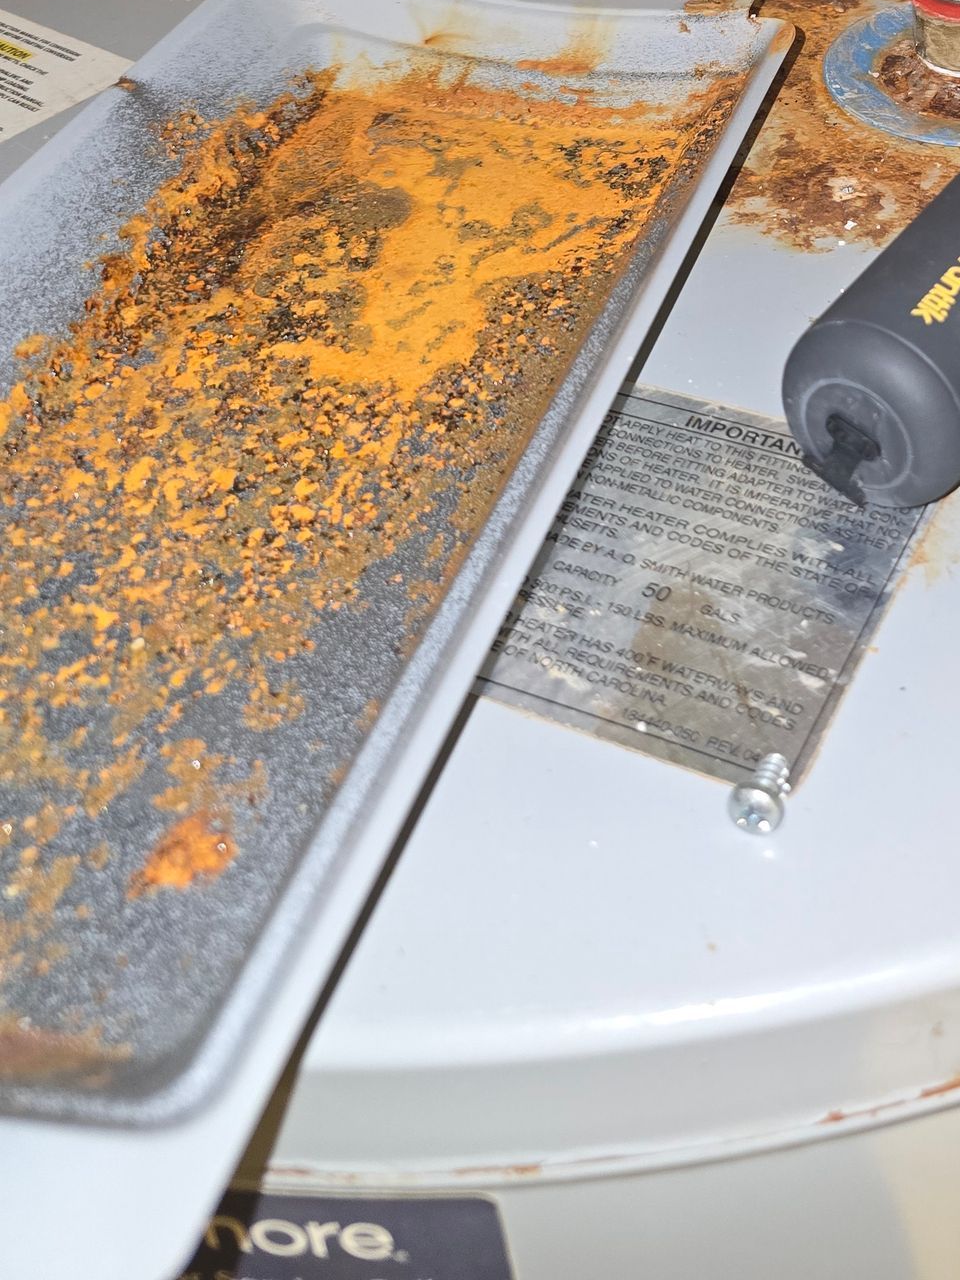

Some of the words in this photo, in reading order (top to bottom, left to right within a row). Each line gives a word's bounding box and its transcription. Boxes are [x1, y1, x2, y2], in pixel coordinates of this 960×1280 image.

[0, 40, 33, 60] AUTION
[612, 426, 703, 460] CONNECTIONS
[704, 452, 722, 463] TO
[724, 457, 781, 480] HEATER.
[620, 417, 662, 435] APPLY
[667, 429, 701, 446] HEAT
[701, 438, 722, 451] TO
[724, 444, 756, 460] THIS
[757, 453, 812, 475] FITTING
[685, 414, 803, 458] IMPORTAN
[584, 470, 682, 506] NON-METALLIC
[682, 498, 781, 534] COMPONENTS.
[592, 461, 651, 485] APPLIED
[653, 477, 671, 489] TO
[673, 482, 721, 503] WATER
[723, 495, 830, 534] CONNECTIONS
[833, 527, 852, 538] AS
[854, 533, 895, 551] THEY
[615, 440, 670, 464] BEFORE
[674, 456, 726, 478] FITTING
[727, 470, 794, 496] ADAPTER
[796, 489, 814, 501] TO
[817, 495, 865, 516] WATER
[620, 455, 640, 467] OF
[642, 460, 701, 484] HEATER.
[708, 478, 723, 488] IT
[725, 482, 741, 493] IS
[743, 486, 831, 520] IMPERATIVE
[834, 513, 875, 532] THAT
[878, 525, 901, 538] NO
[552, 513, 621, 539] HUSETTS.
[559, 499, 627, 526] EMENTS
[630, 520, 664, 536] AND
[675, 532, 724, 553] CODES
[727, 548, 748, 560] OF
[755, 556, 787, 572] THE
[789, 566, 837, 587] STATE
[619, 502, 688, 530] HEATER
[693, 522, 789, 558] COMPLIES
[791, 552, 839, 572] WITH
[843, 567, 879, 584] ALL
[552, 559, 623, 587] CAPACITY
[640, 580, 672, 603] 50
[698, 604, 743, 625] GALS
[580, 542, 602, 555] BY
[639, 558, 688, 580] SMITH
[689, 573, 743, 596] WATER
[745, 590, 836, 625] PRODUCTS
[502, 644, 524, 658] OF
[527, 652, 582, 676] NORTH
[606, 602, 634, 617] 150
[669, 621, 747, 652] MAXIMUM
[514, 617, 577, 643] HEATER
[578, 636, 613, 653] HAS
[660, 660, 767, 700] WATERWAYS
[764, 695, 805, 715] AND
[532, 637, 564, 654] ALL
[563, 647, 695, 695] REQUIREMENTS
[694, 689, 733, 708] AND
[732, 702, 798, 730] CODES
